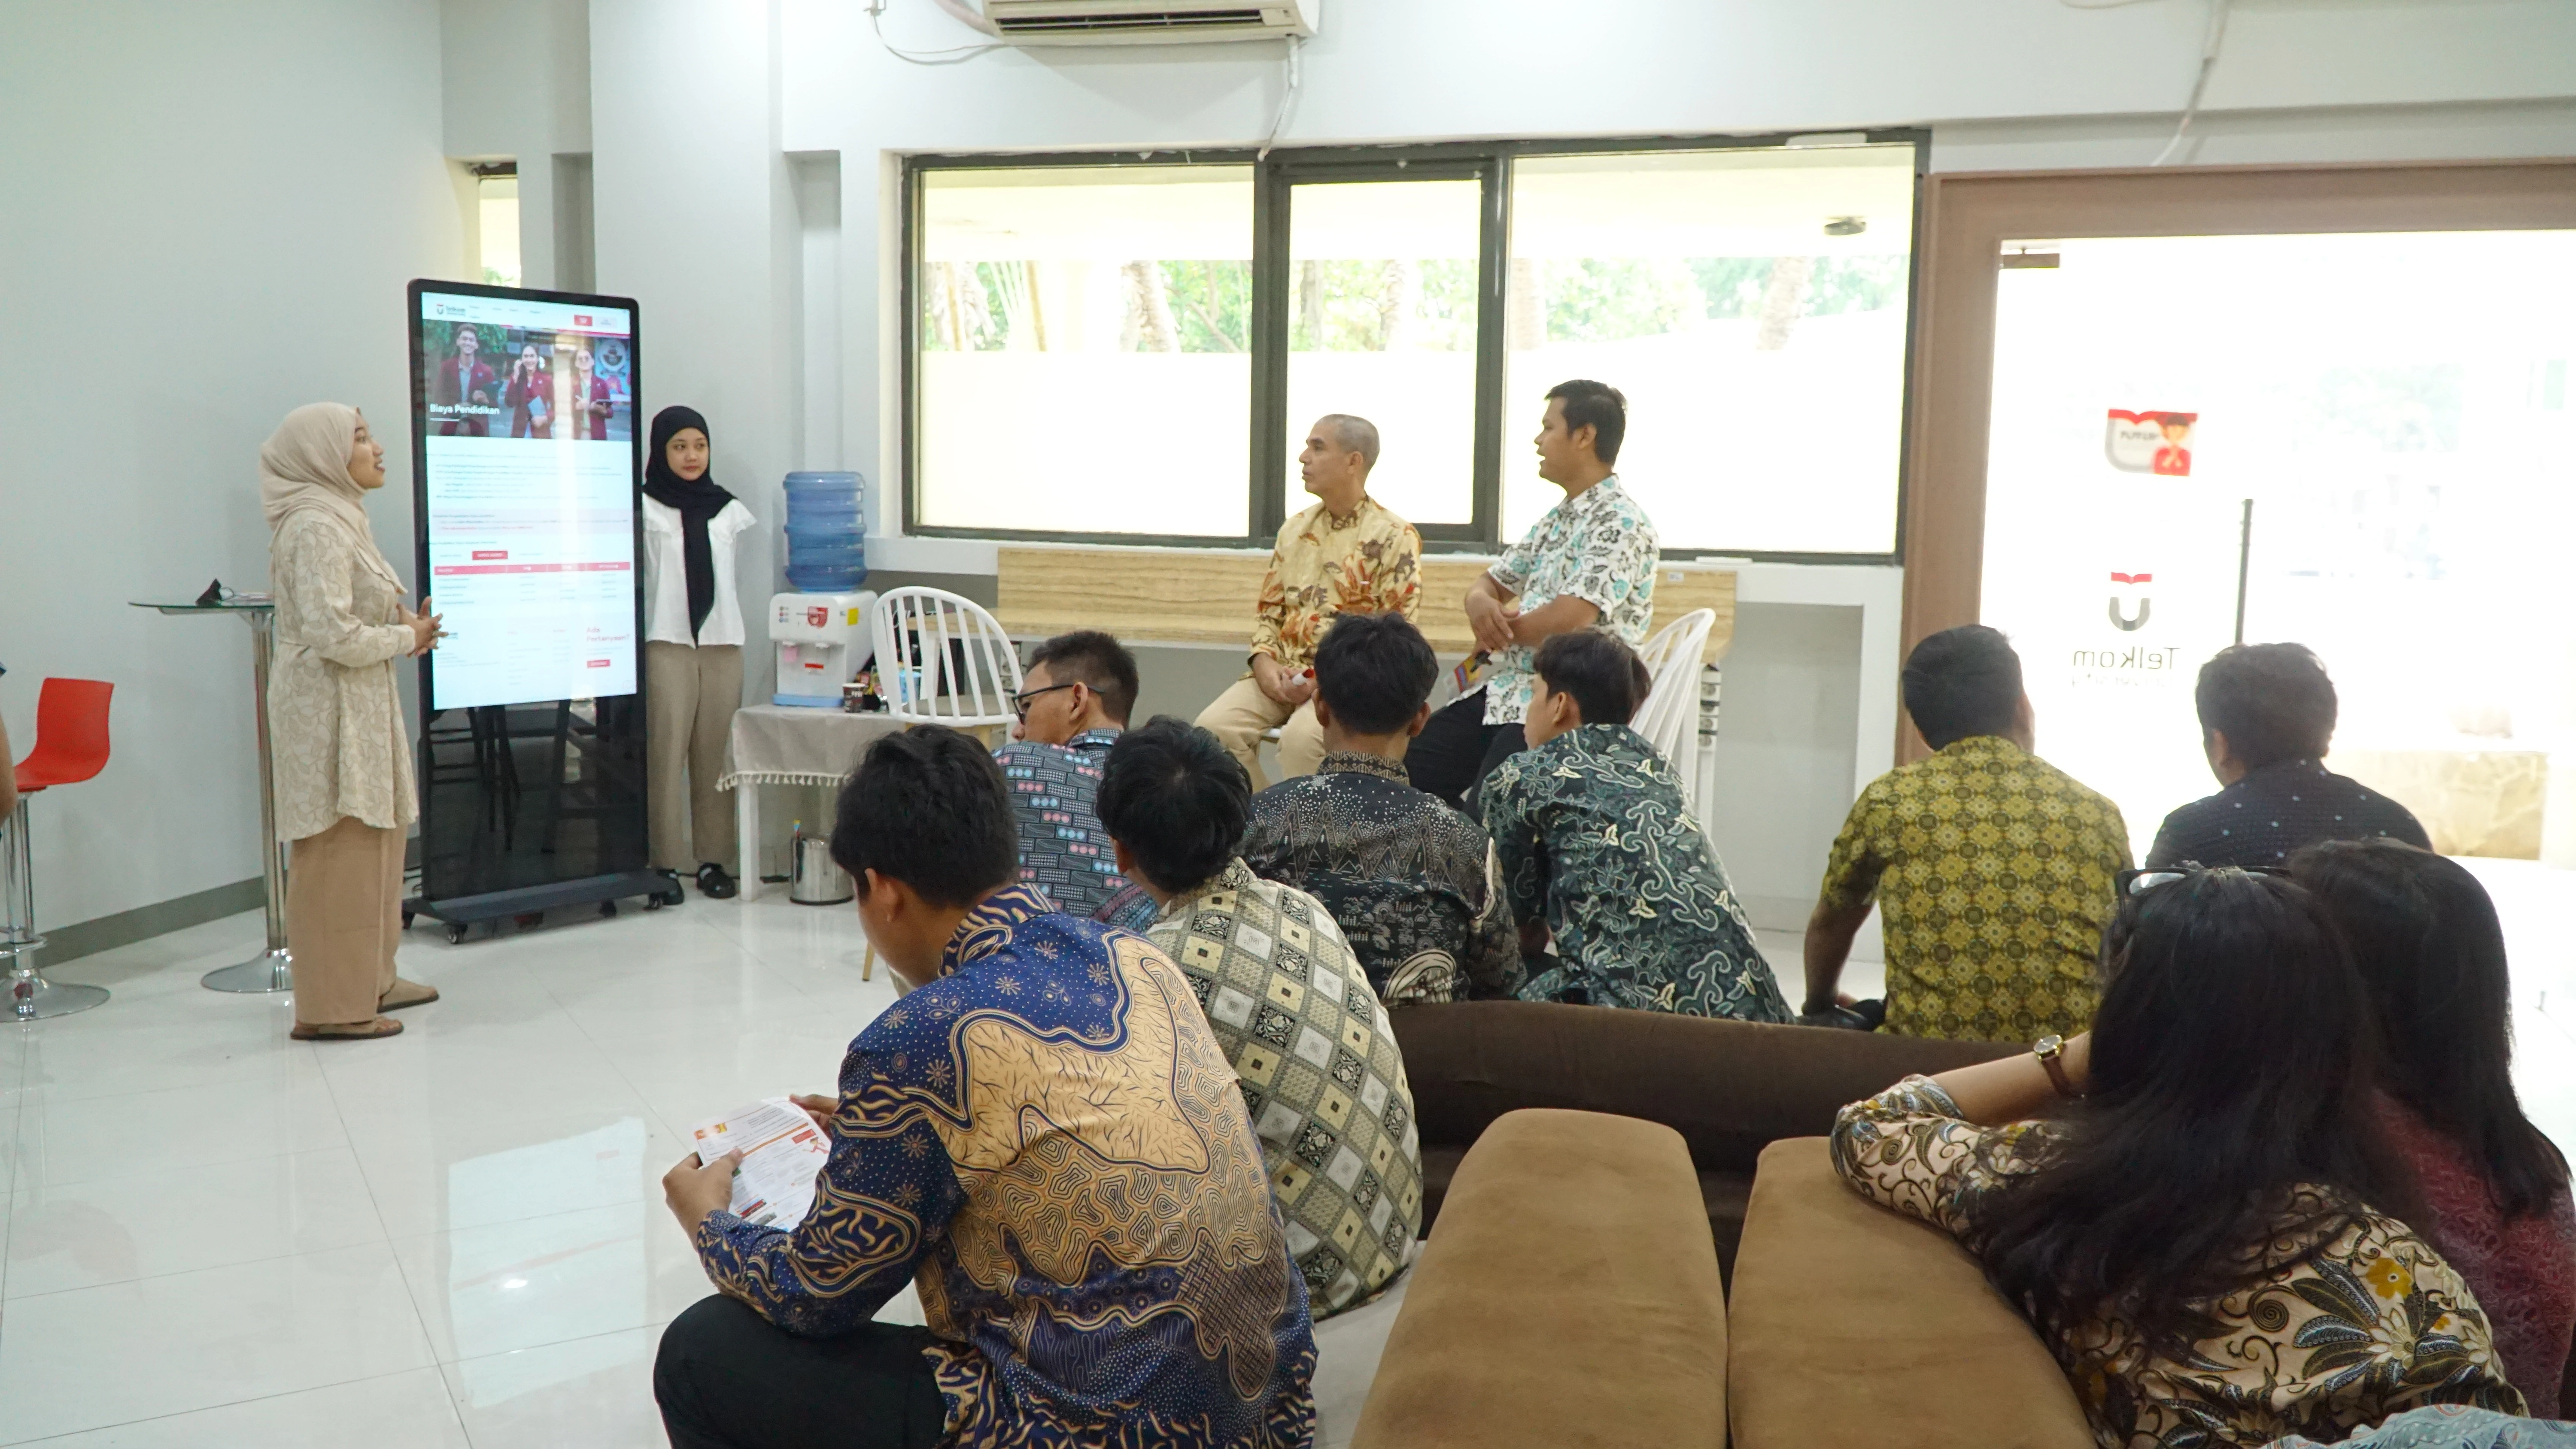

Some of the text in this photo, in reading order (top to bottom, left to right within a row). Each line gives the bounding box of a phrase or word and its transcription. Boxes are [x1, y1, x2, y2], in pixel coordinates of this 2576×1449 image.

[430, 403, 500, 415] Biaya Pendidikan
[586, 634, 630, 643] Pertanyaan?
